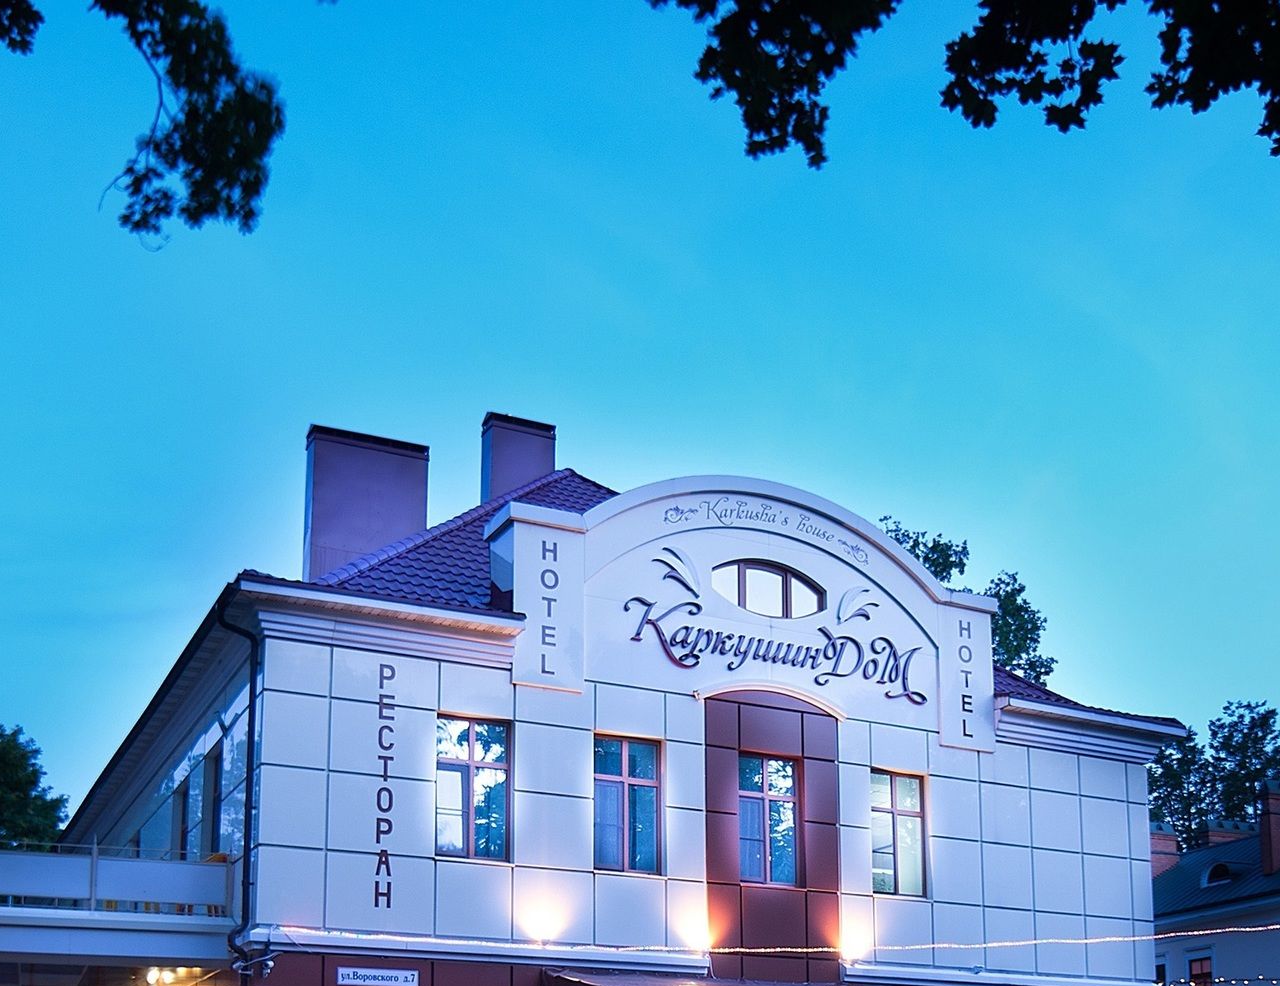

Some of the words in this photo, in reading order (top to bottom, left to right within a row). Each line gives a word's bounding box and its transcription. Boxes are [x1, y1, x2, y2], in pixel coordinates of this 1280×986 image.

[699, 497, 789, 526] Karkusha's
[795, 514, 835, 542] house
[540, 540, 559, 676] HOTEL
[623, 596, 824, 669] Каркушин
[958, 619, 973, 738] HOTEL
[374, 663, 396, 909] РЕСТОРАН
